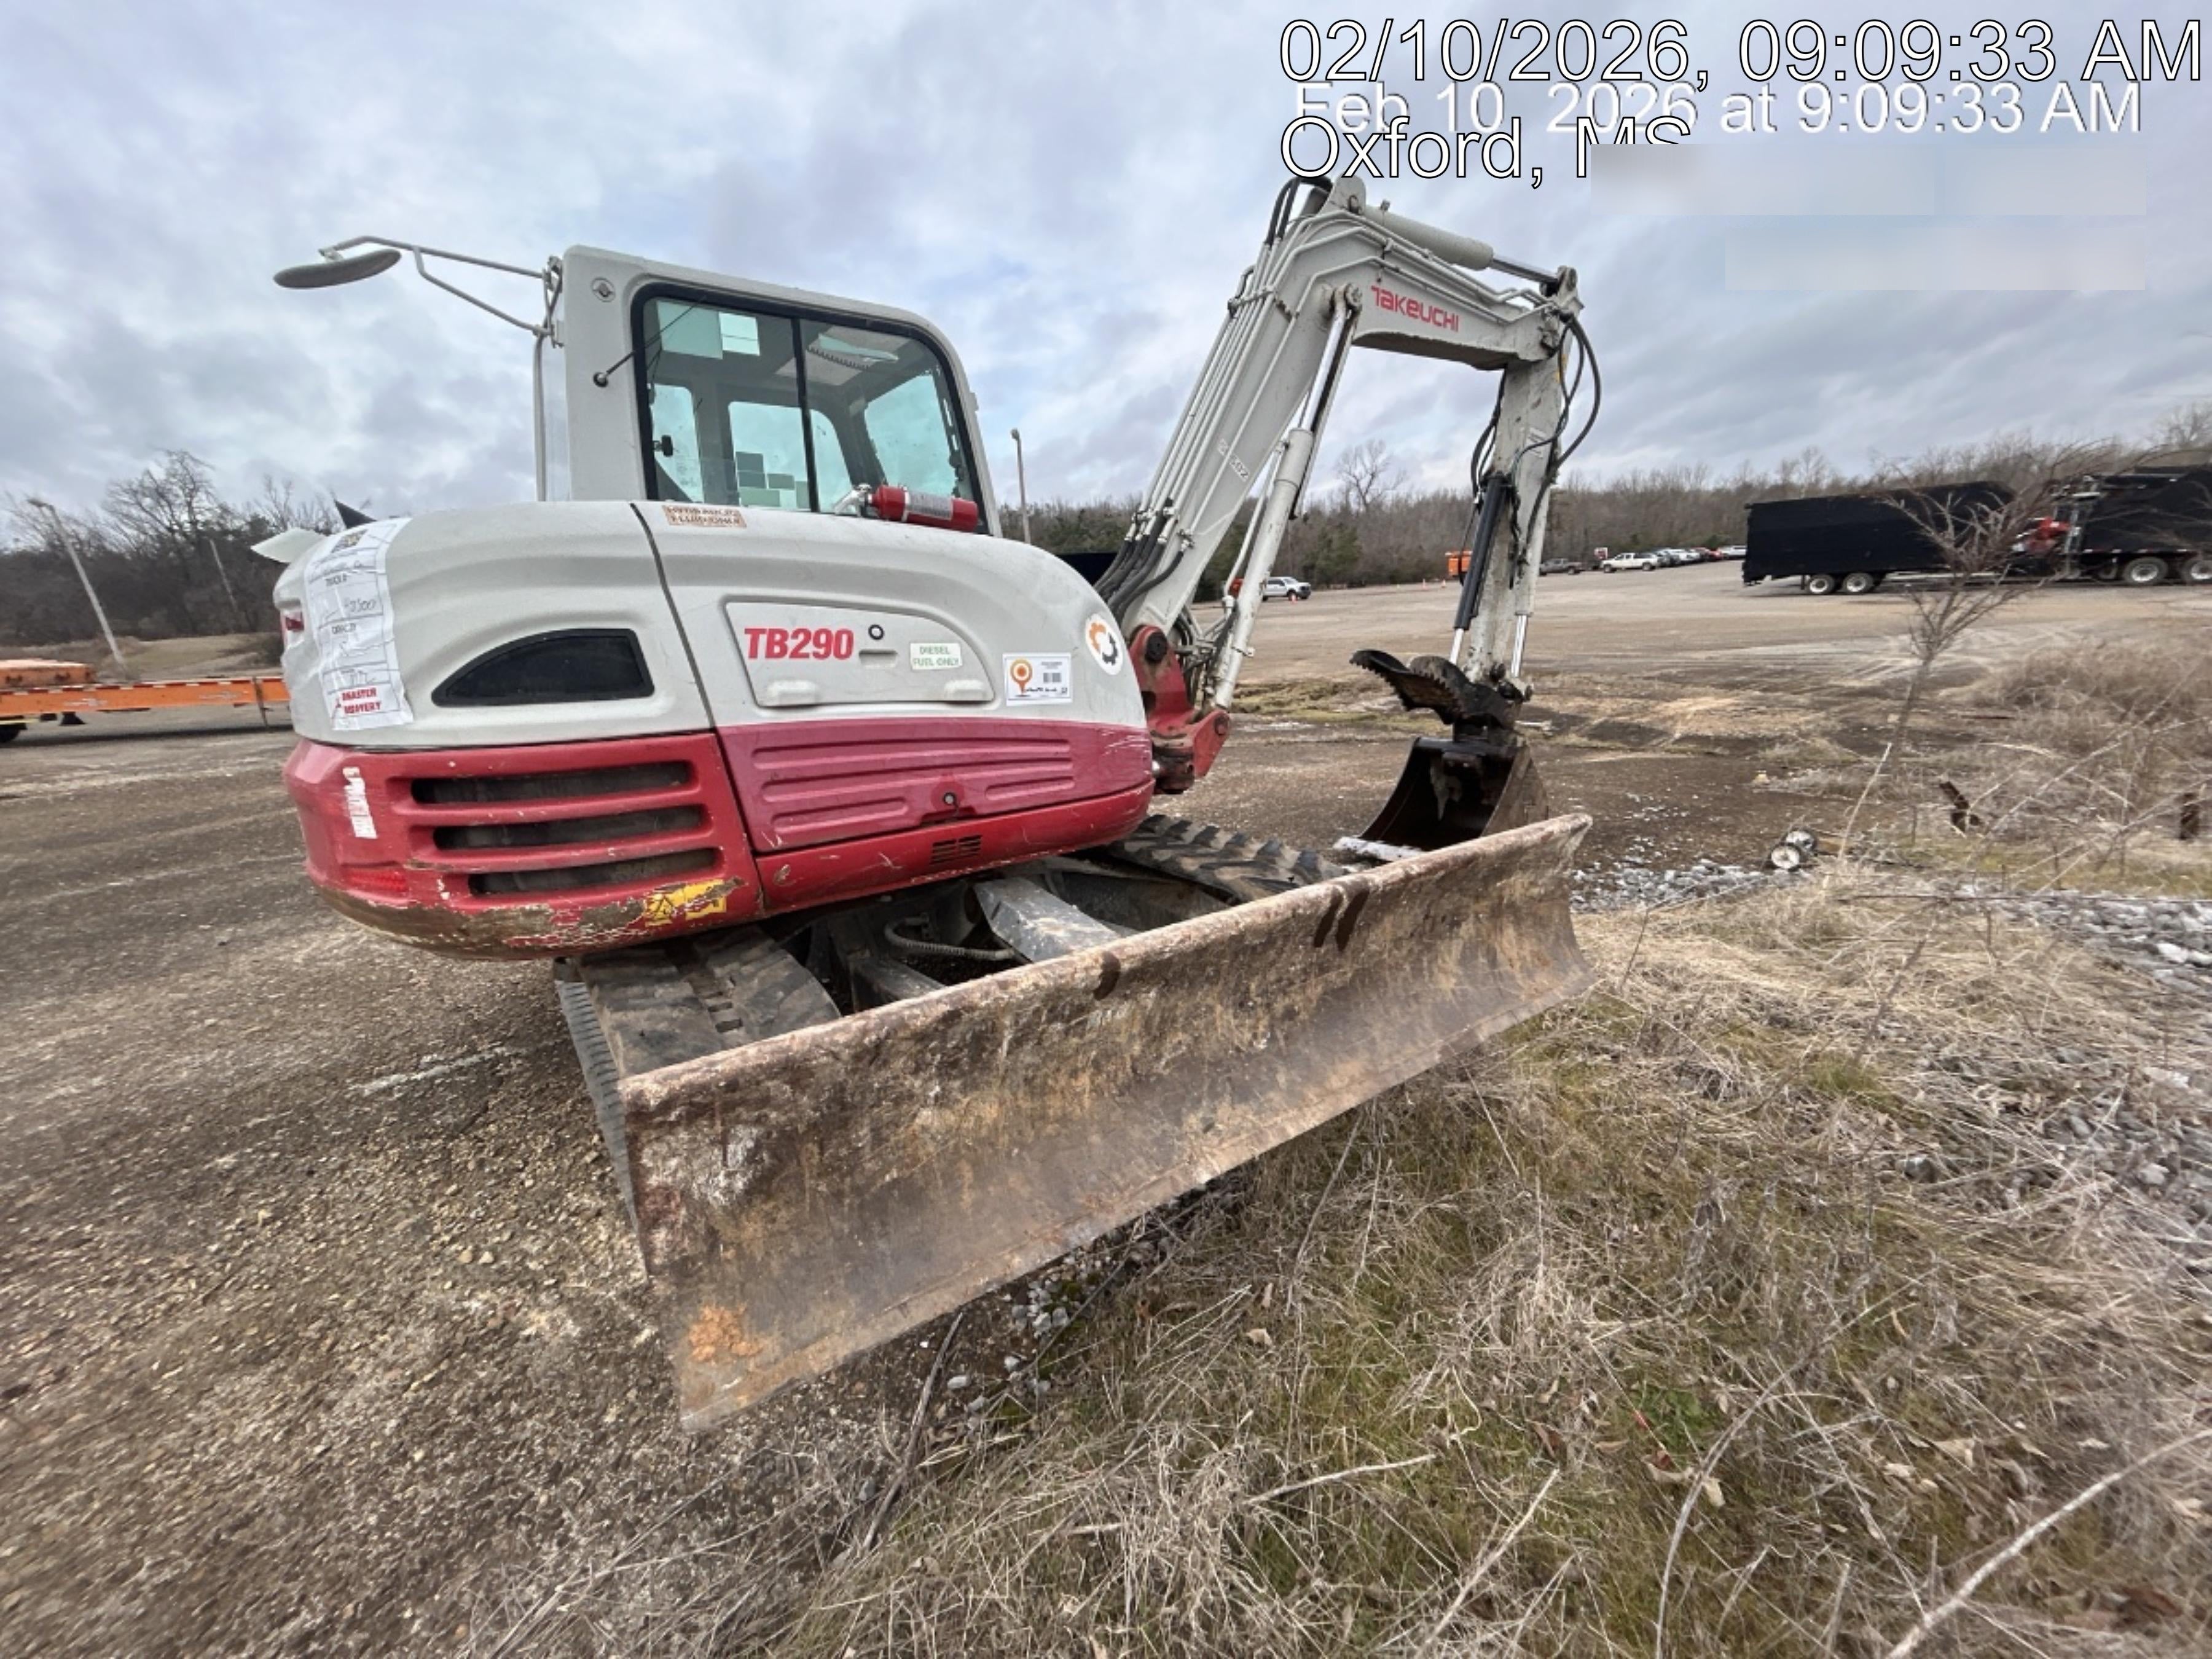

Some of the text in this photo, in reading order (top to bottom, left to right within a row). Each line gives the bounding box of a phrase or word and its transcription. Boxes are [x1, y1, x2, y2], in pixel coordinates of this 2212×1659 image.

[744, 628, 854, 660] TB290
[919, 646, 951, 655] DIESEL
[913, 657, 959, 666] FUEL ONLY
